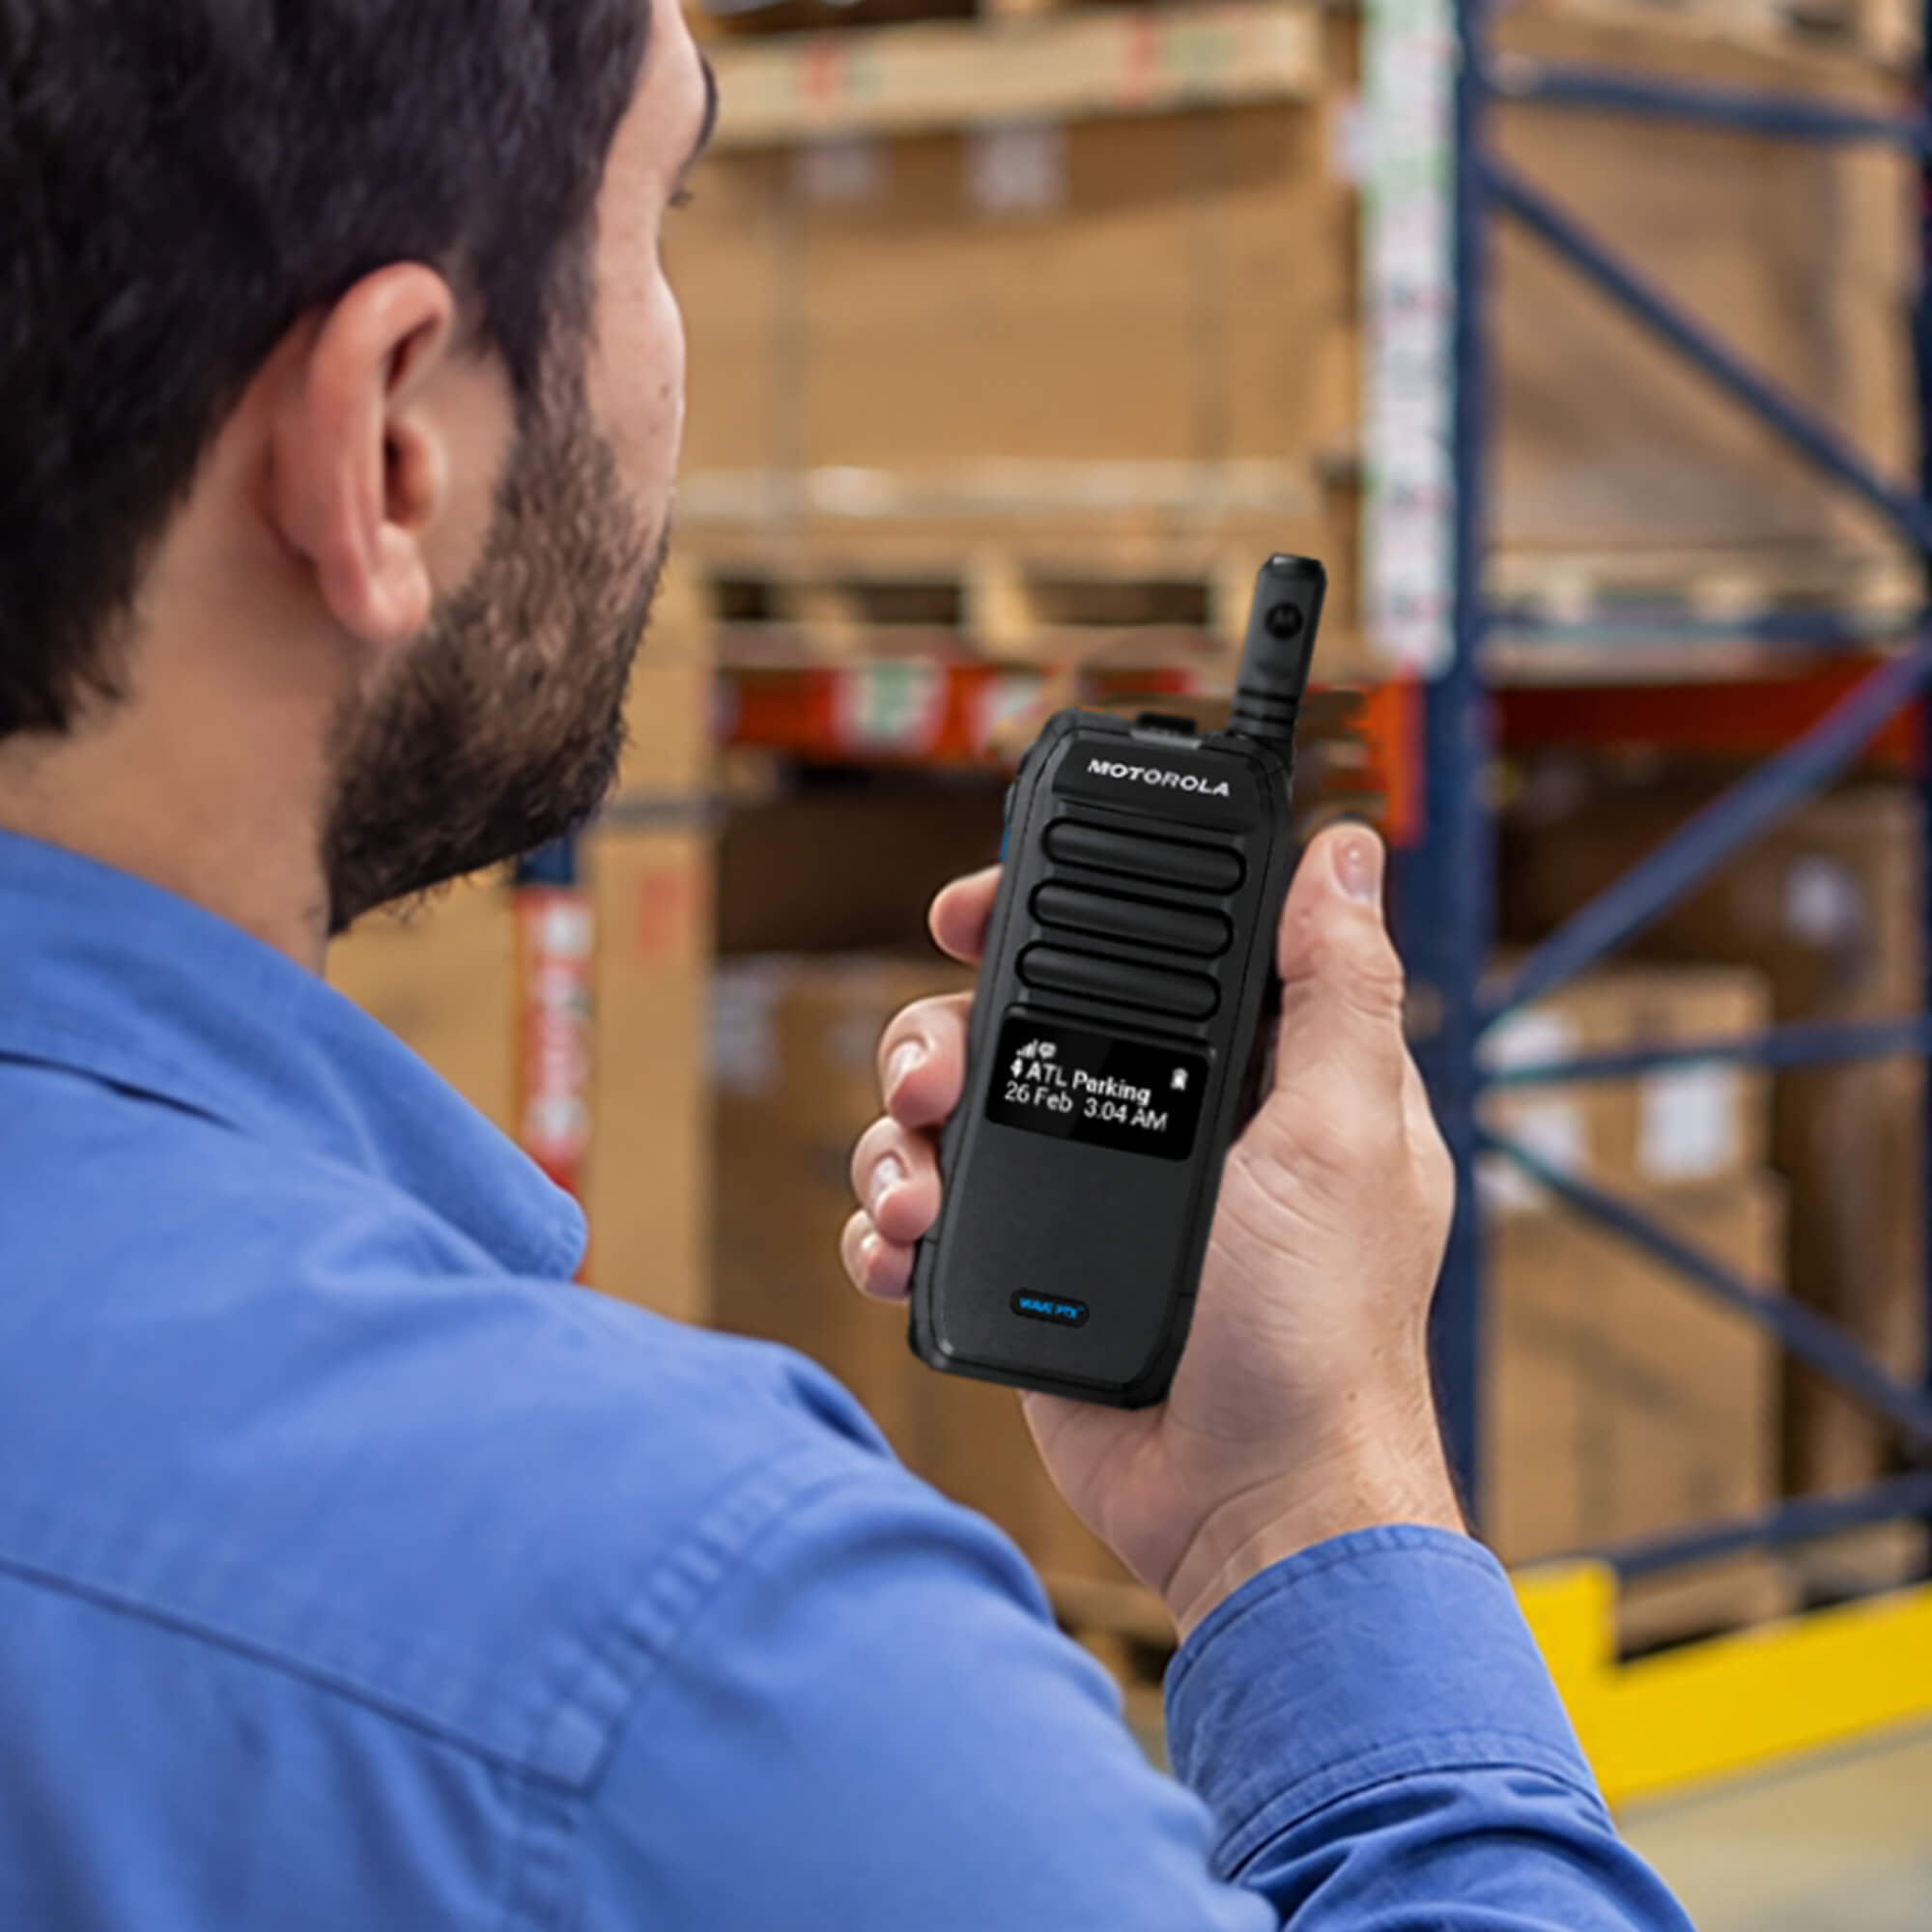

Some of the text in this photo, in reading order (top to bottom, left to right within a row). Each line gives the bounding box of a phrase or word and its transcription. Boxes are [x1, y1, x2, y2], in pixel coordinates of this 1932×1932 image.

[1088, 758, 1230, 797] MOTOROLA
[1005, 1080, 1030, 1103] 26
[1034, 1087, 1073, 1113] Feb
[1130, 1108, 1168, 1131] AM
[1026, 1062, 1151, 1106] ATL Parking
